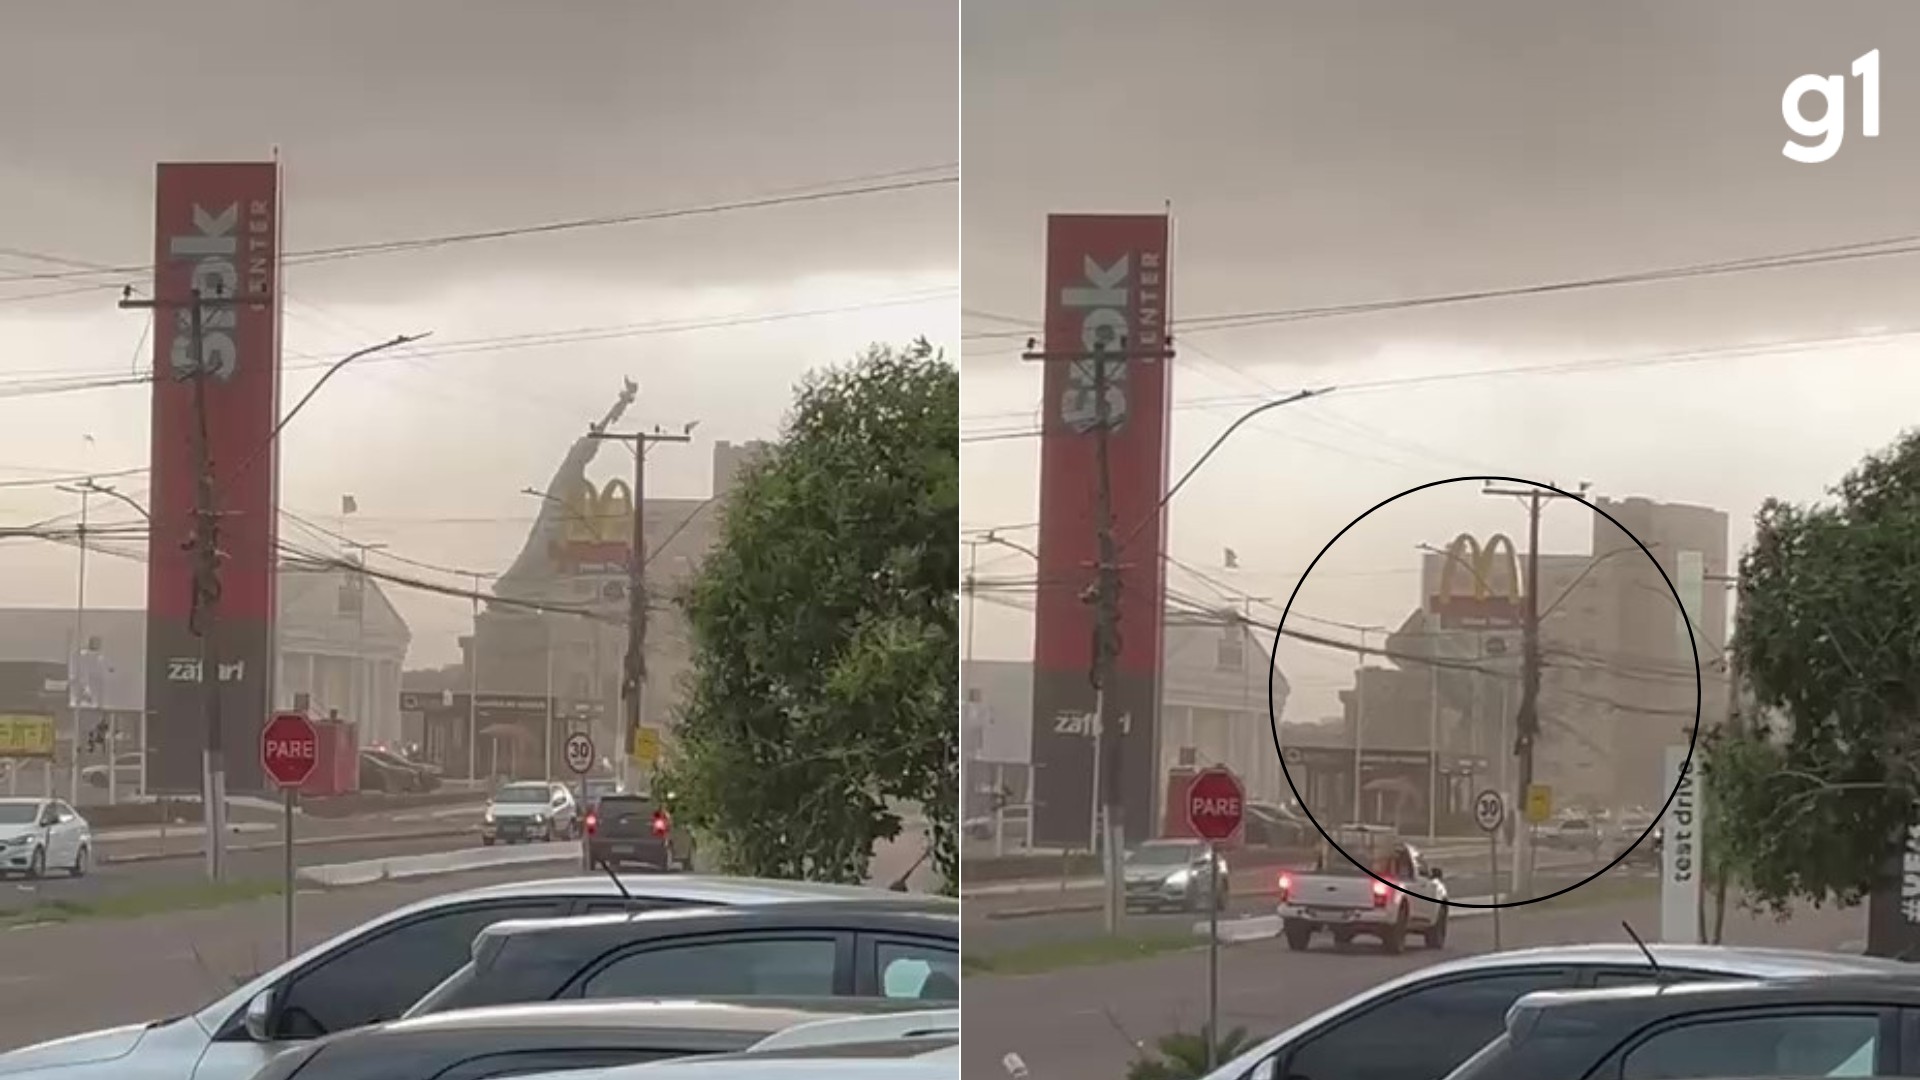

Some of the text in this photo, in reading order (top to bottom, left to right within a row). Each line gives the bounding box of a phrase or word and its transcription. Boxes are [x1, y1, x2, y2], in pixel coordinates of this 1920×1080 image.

[266, 739, 313, 758] PARE
[570, 742, 589, 758] 30
[1192, 799, 1239, 816] PARE
[1481, 799, 1499, 816] 30
[1673, 761, 1693, 882] test drive
